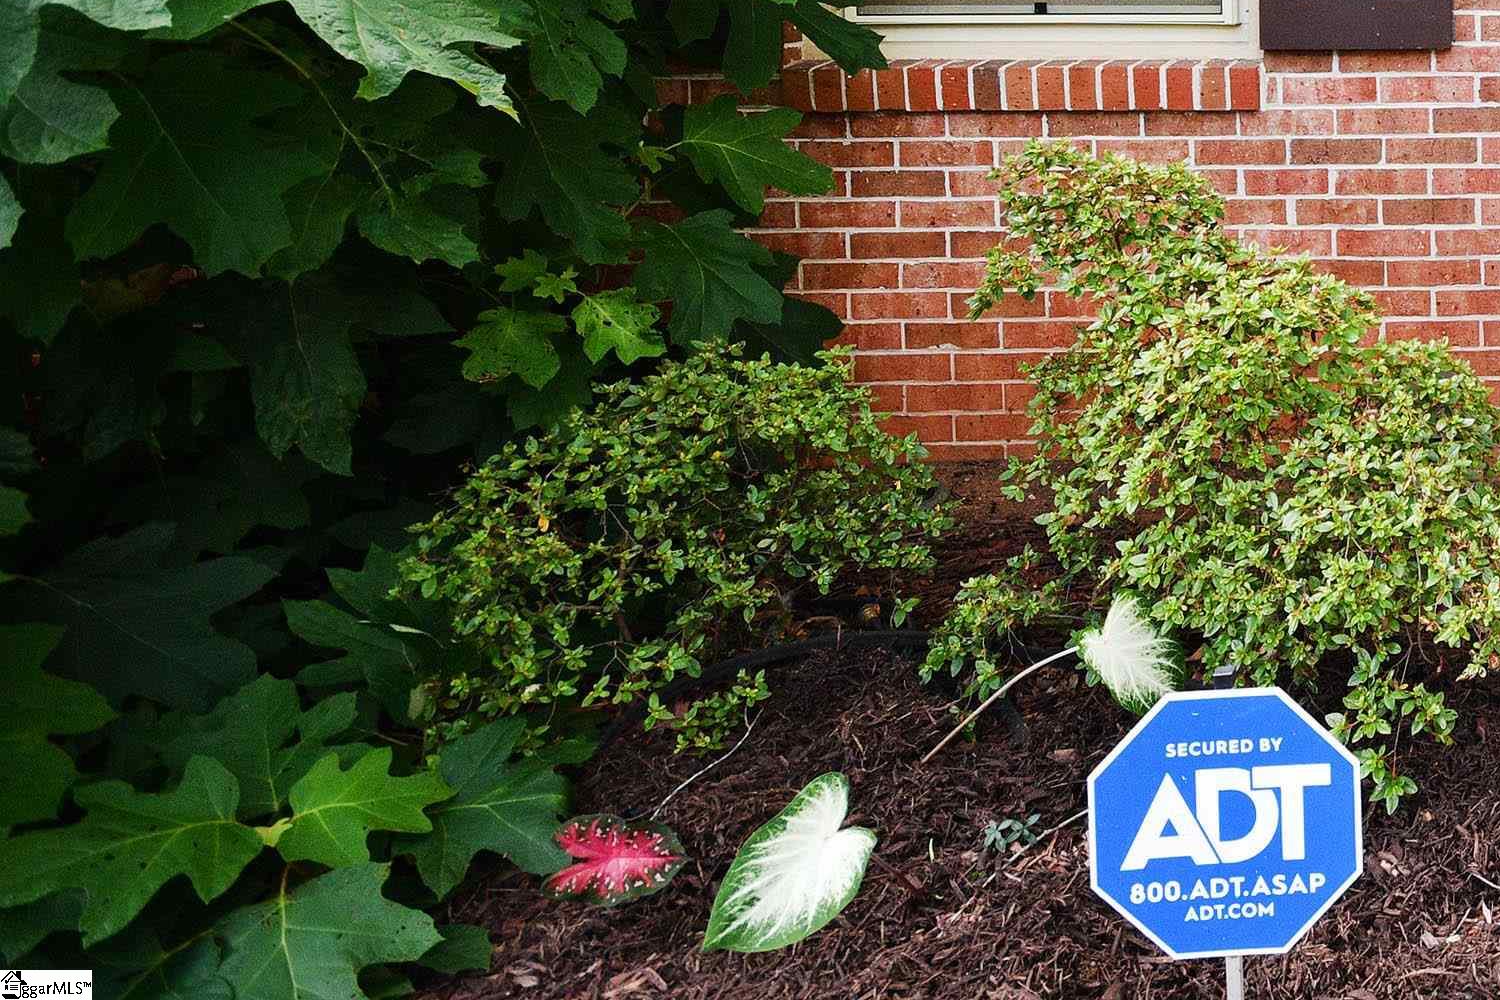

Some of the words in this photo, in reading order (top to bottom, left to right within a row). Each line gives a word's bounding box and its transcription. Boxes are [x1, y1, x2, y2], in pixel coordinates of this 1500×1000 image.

[1165, 738, 1254, 758] SECURED
[1259, 737, 1283, 752] BY
[1119, 763, 1332, 871] ADT
[1129, 872, 1326, 905] 800.ADT.ASAP
[1183, 901, 1275, 922] ADT.COM
